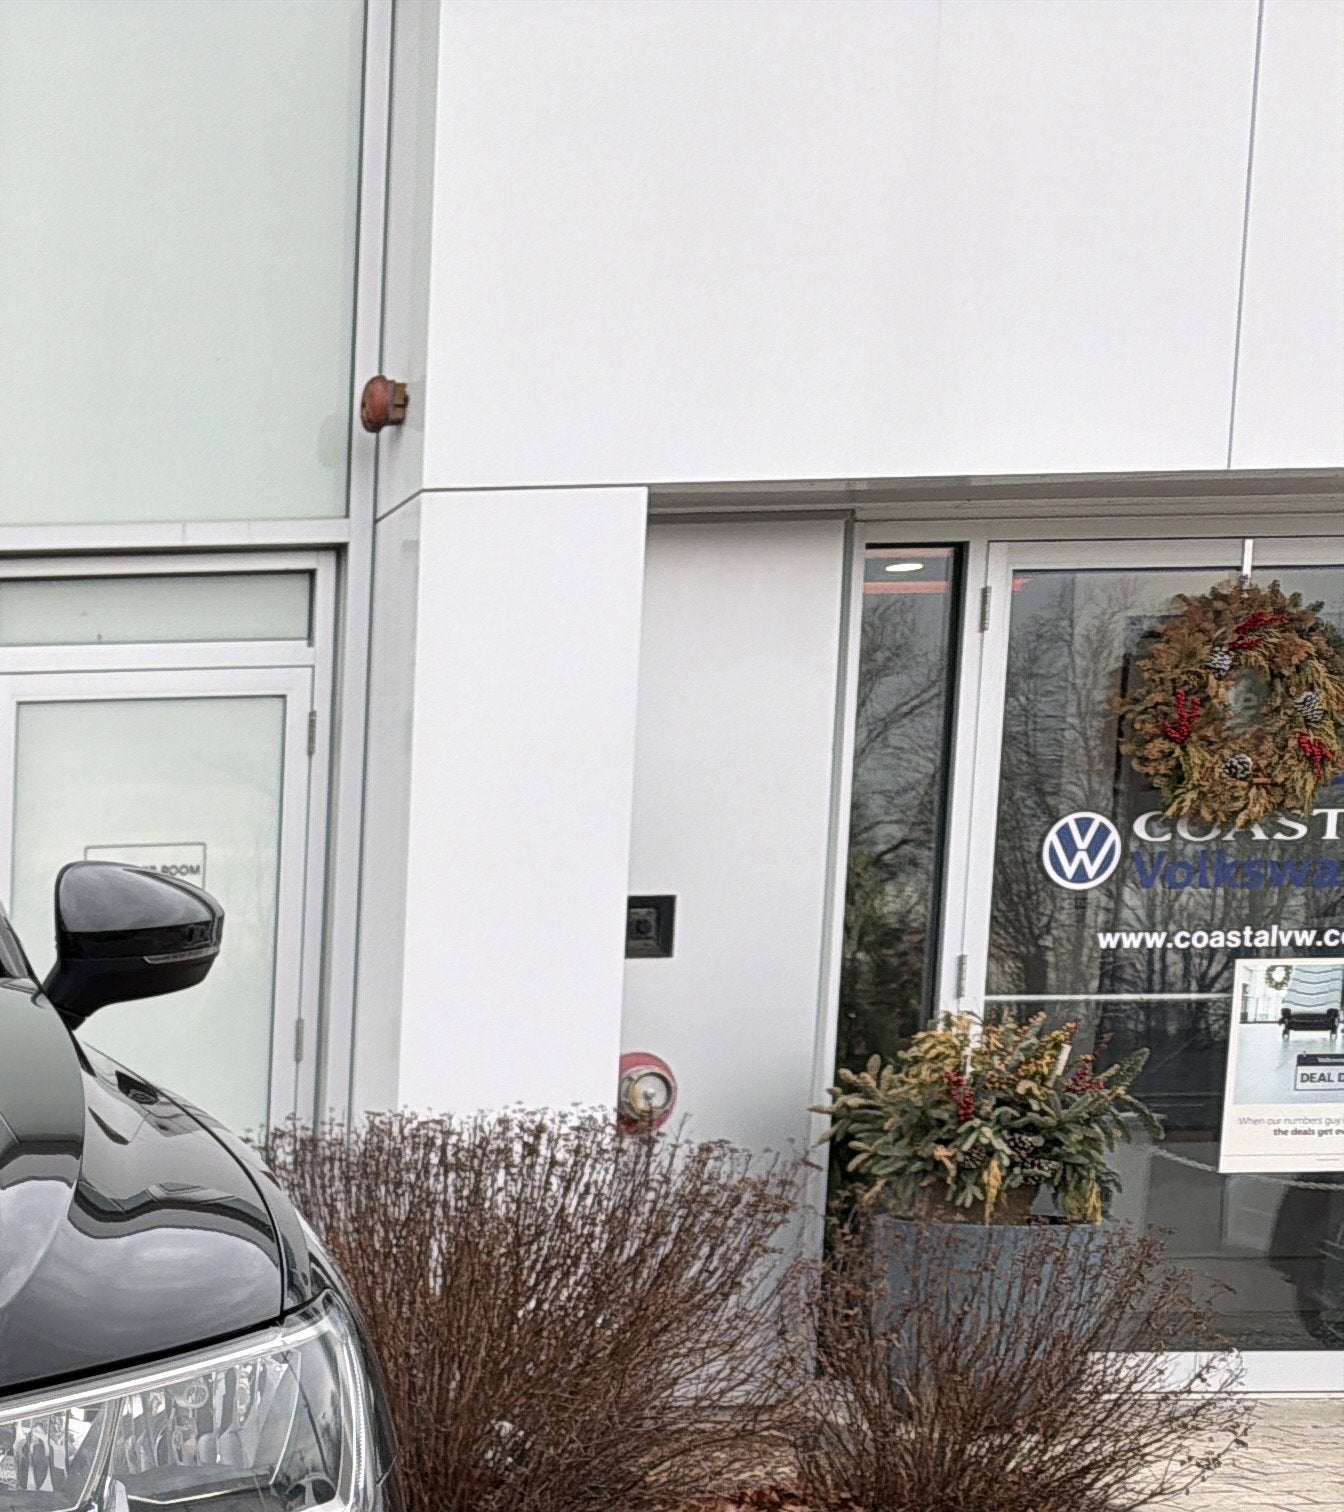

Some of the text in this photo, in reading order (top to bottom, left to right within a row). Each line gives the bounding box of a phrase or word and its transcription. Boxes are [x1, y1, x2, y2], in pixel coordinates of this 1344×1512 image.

[1131, 849, 1340, 890] Volkswa
[1097, 925, 1344, 949] www.coastalvw.c
[1301, 1072, 1334, 1083] DEAL
[1239, 1117, 1266, 1126] When
[1283, 1117, 1323, 1125] numbers
[1324, 1118, 1340, 1127] guy
[1273, 1128, 1289, 1136] the
[1290, 1127, 1316, 1136] deals
[1317, 1128, 1333, 1137] get
